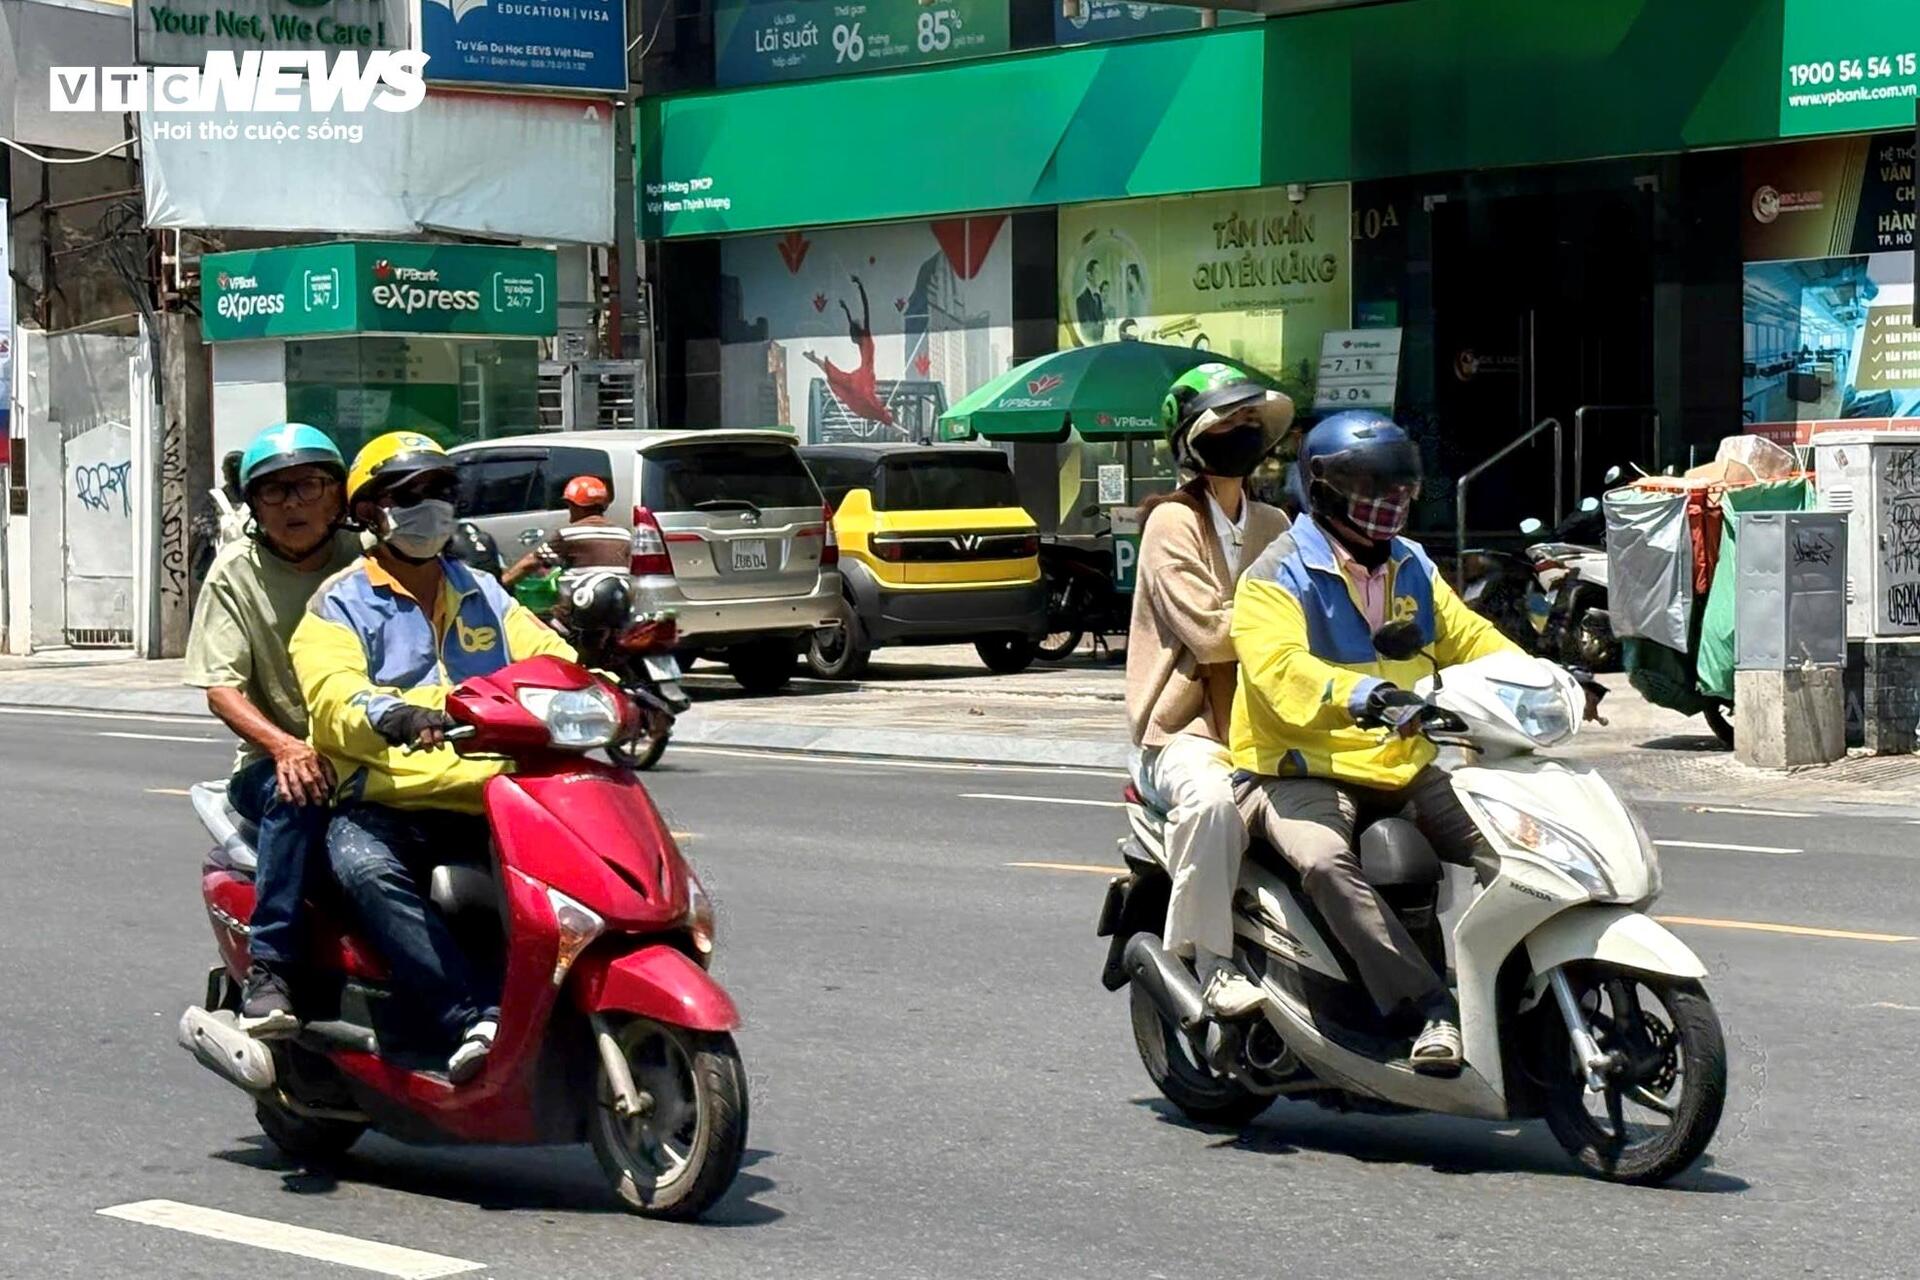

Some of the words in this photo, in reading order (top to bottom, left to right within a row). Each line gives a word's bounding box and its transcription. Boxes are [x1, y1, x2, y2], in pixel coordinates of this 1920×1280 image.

[497, 3, 571, 20] EDUCATION
[579, 9, 609, 22] VISA
[150, 7, 211, 35] Your
[215, 10, 266, 43] Net,
[272, 14, 313, 42] We
[316, 16, 372, 46] Care
[755, 28, 779, 52] Lãi
[782, 20, 819, 50] suất
[455, 40, 469, 51] Tư
[469, 40, 489, 52] Vấn
[490, 42, 504, 53] Du
[505, 44, 524, 55] Học
[553, 46, 571, 59] Việt
[573, 48, 594, 59] Nam
[832, 22, 865, 64] 96
[1788, 61, 1835, 87] 1900
[1838, 59, 1864, 82] 54
[1867, 56, 1892, 79] 54
[1895, 53, 1917, 76] 15
[1788, 84, 1918, 107] www.vpbank.com.vn
[1880, 162, 1911, 182] VĂN
[668, 181, 690, 194] Hàng
[663, 201, 682, 212] Nam
[682, 199, 705, 213] Thịnh
[1262, 209, 1316, 247] NHÌN
[1877, 234, 1893, 246] TP.
[229, 276, 258, 290] VPBank
[393, 267, 439, 282] VPBank
[217, 293, 285, 323] eXpress
[371, 283, 481, 315] eXpress
[506, 295, 532, 308] 24/7
[999, 398, 1052, 409] VPBank
[1112, 416, 1156, 428] VPBank
[1115, 539, 1136, 581] P
[456, 616, 497, 653] be
